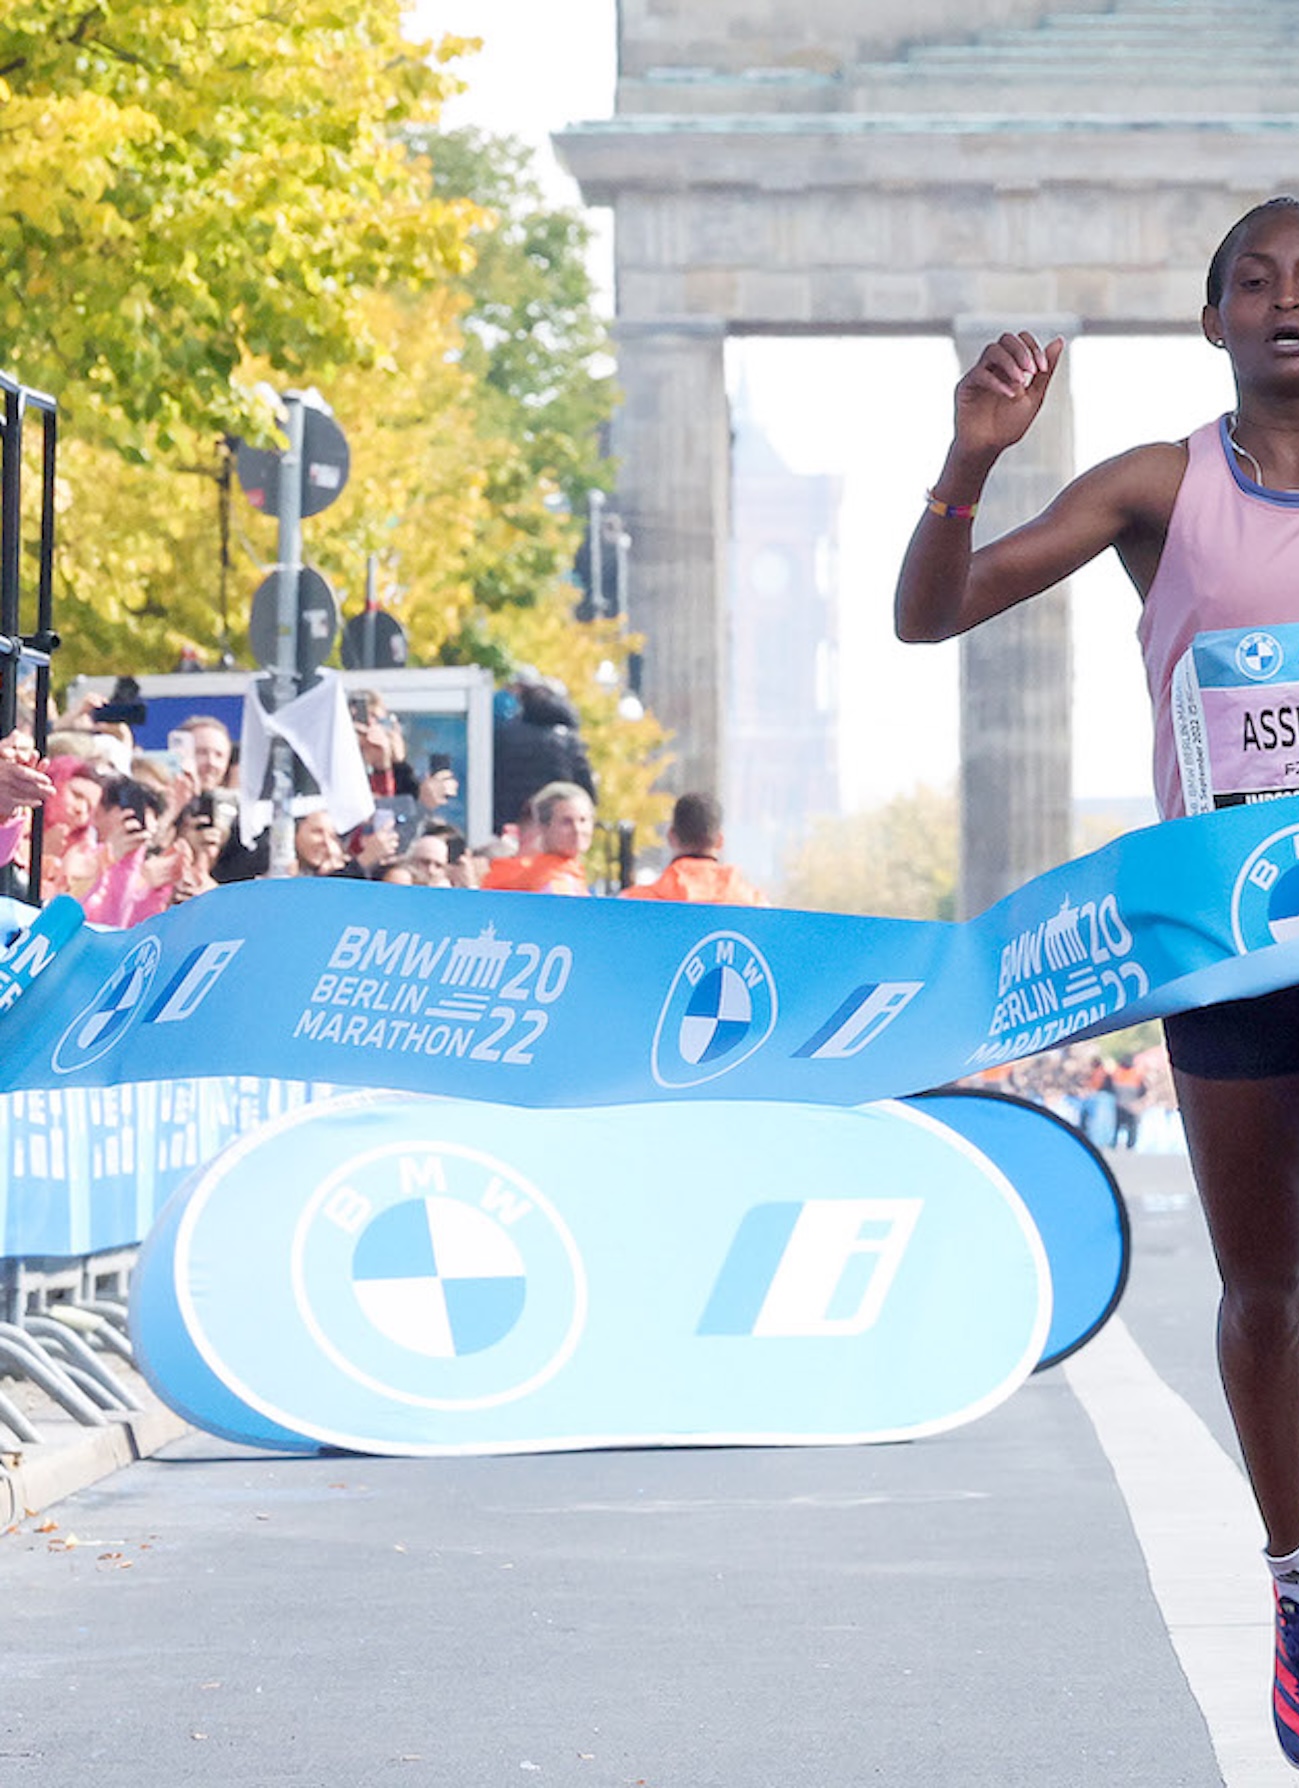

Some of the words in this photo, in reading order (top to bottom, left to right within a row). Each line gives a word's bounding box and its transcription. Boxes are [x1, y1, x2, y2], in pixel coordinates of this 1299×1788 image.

[1189, 718, 1202, 744] 2022
[1079, 893, 1133, 965] 20
[327, 926, 450, 980] BMW
[498, 942, 574, 1004] 20
[684, 940, 765, 989] BMW
[310, 974, 429, 1015] BERLIN
[987, 978, 1060, 1037] BERLIN
[292, 1009, 476, 1058] MARATHON
[469, 1006, 550, 1066] 22
[323, 1156, 533, 1235] BMW
